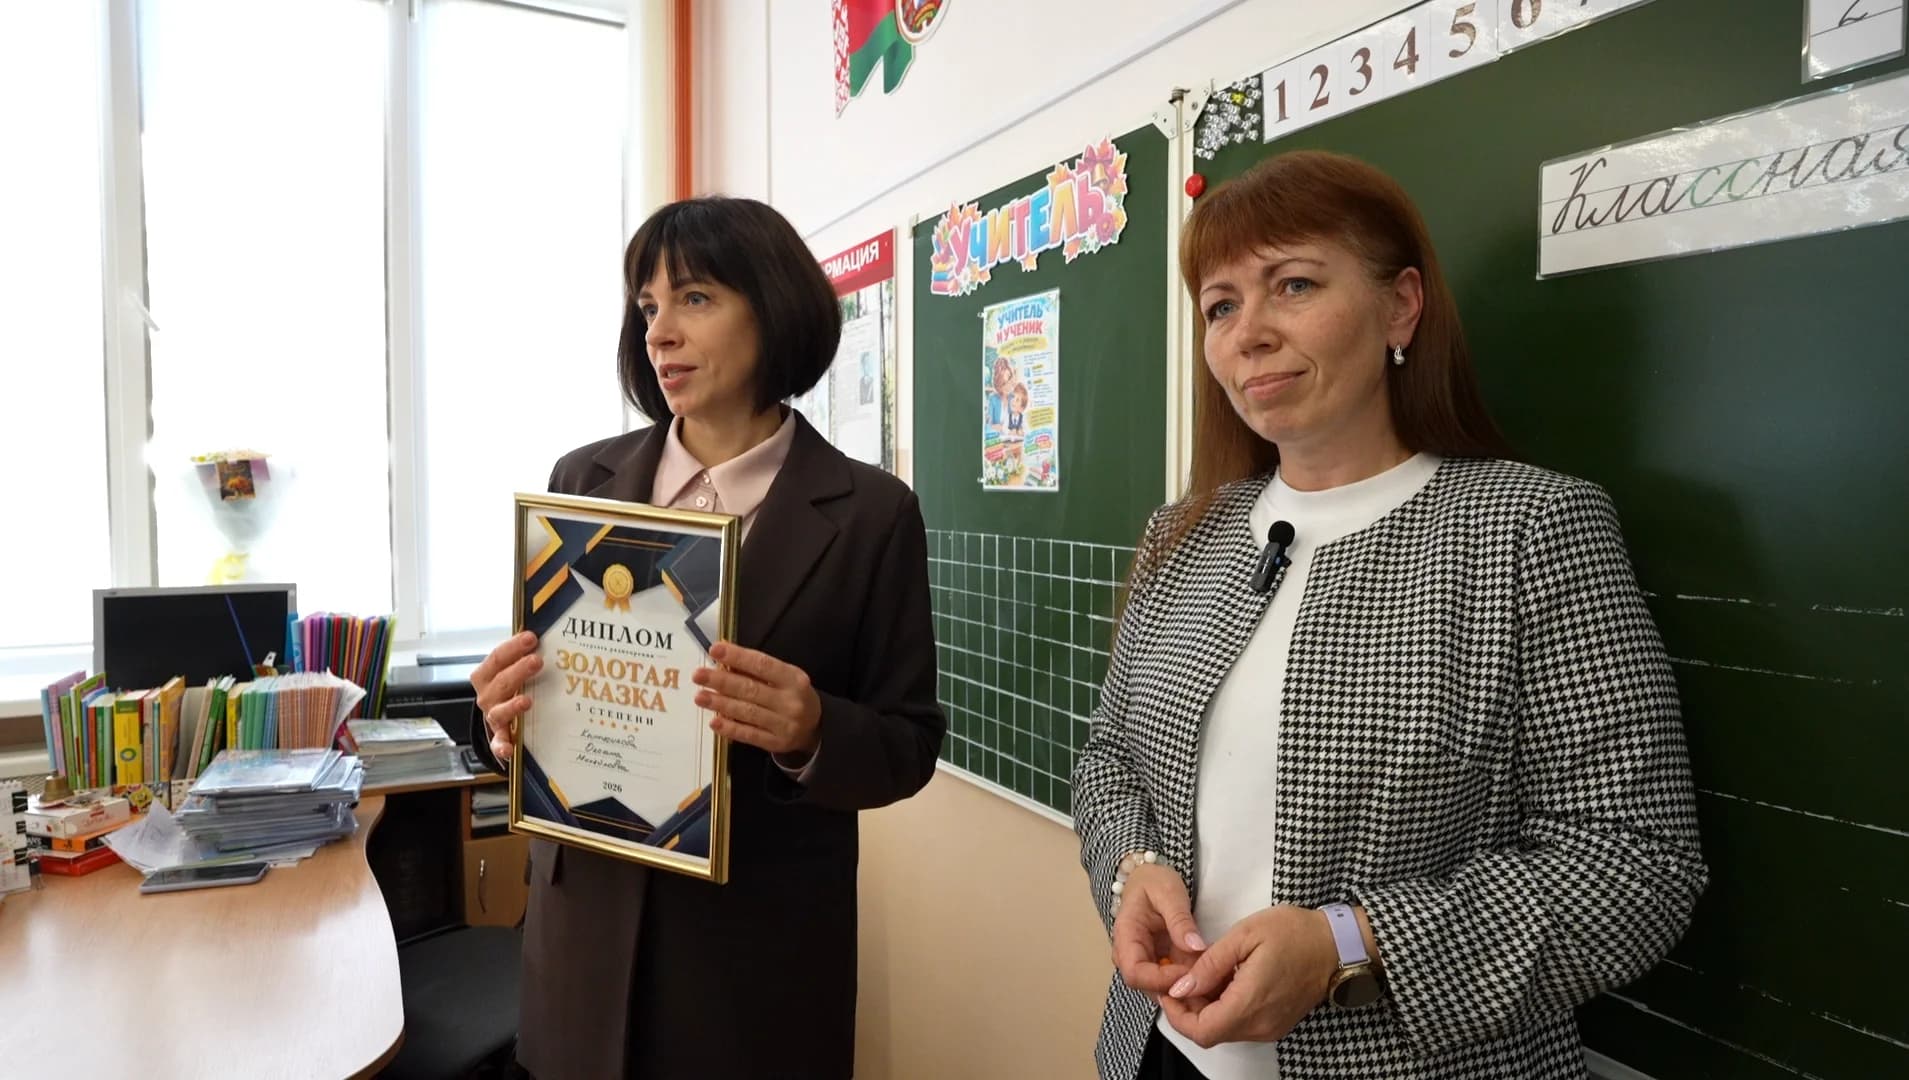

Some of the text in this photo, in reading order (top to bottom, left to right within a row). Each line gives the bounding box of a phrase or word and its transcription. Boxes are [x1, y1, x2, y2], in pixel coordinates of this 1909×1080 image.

[1274, 79, 1290, 123] 1
[1308, 63, 1331, 111] 2
[1348, 46, 1373, 96] 3
[1393, 26, 1420, 76] 4
[1448, 2, 1477, 58] 5
[949, 170, 1105, 278] УЧИТЕЛЬ
[824, 240, 880, 279] РМАЦИЯ
[997, 303, 1043, 329] УЧИТЕЛЬ
[1003, 320, 1043, 341] УЧЕНИК
[562, 616, 674, 650] ДИПЛОМ
[555, 648, 681, 690] ЗОЛОТАЯ
[565, 673, 668, 713] УКАЗКА
[589, 705, 655, 727] СТЕПЕНИ
[602, 780, 623, 793] 2026
